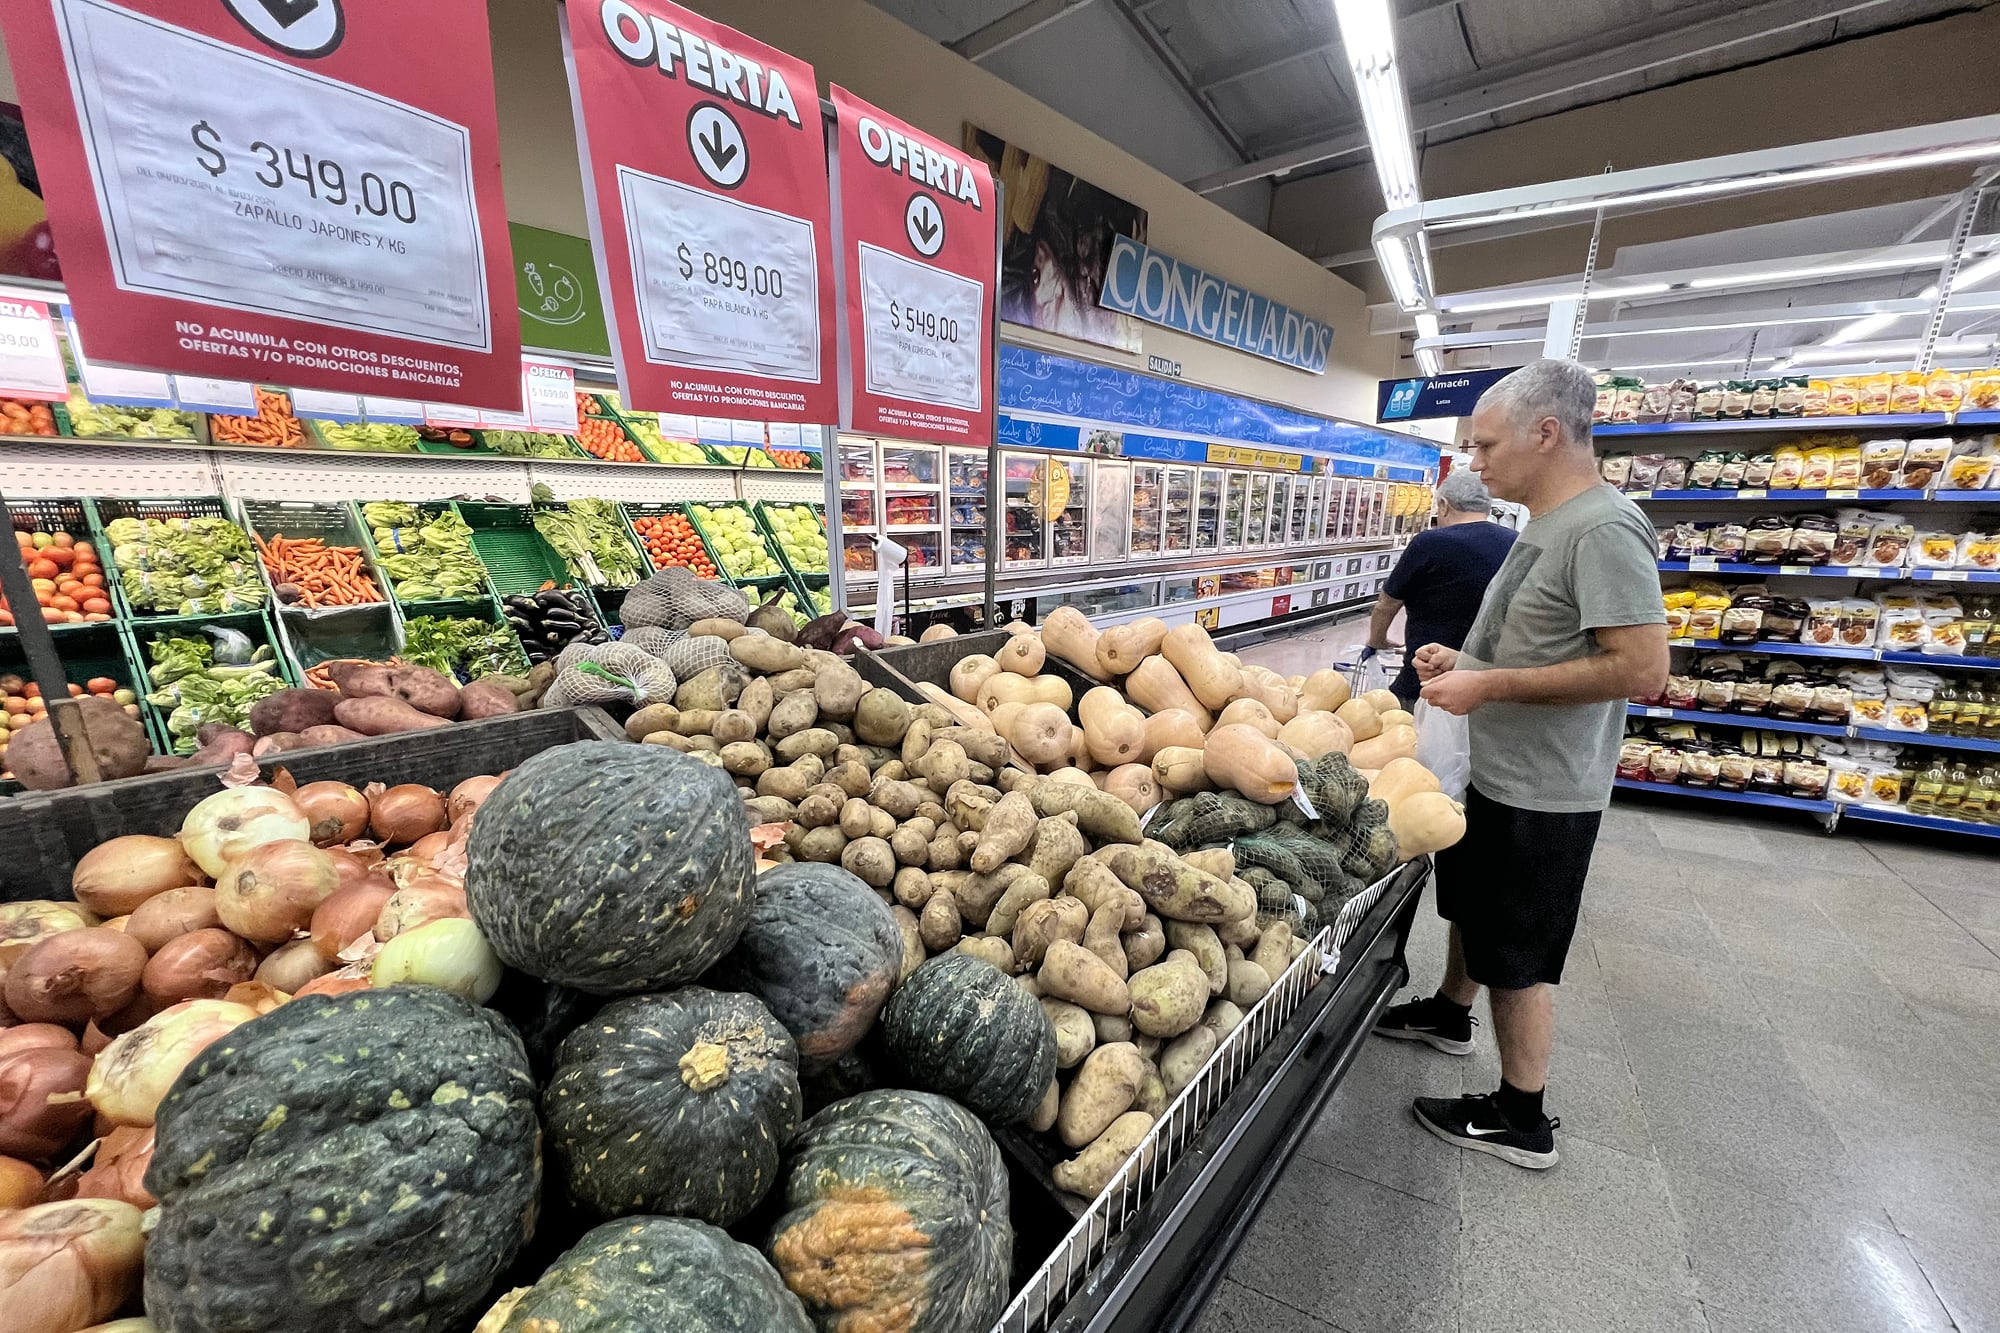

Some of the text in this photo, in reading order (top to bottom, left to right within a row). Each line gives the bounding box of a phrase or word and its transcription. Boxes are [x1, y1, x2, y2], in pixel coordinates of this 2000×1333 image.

[601, 0, 802, 128] OFERTA
[191, 119, 417, 224] $ 349,00
[858, 116, 981, 210] OFERTA
[233, 201, 406, 255] ZAPALLO JAPONES X KG
[677, 242, 693, 281] $
[703, 252, 783, 298] 899,00
[703, 297, 723, 310] PAPA
[725, 300, 751, 317] BLANCA
[759, 309, 769, 320] KG
[890, 300, 958, 343] $ 549,00
[1108, 242, 1329, 370] CONGELADOS
[175, 320, 463, 377] NO ACUMULA CON OTROS DESCUENTOS,
[179, 338, 249, 358] OFERTAS
[287, 353, 389, 377] PROMOCIONES
[391, 369, 461, 387] BANCARIAS
[1000, 349, 1031, 371] gelados
[1149, 357, 1172, 375] SALIDA
[529, 366, 569, 380] OFERTA
[670, 380, 683, 389] NO
[684, 382, 722, 393] ACUMULA
[724, 386, 742, 395] CON
[743, 388, 764, 398] OTROS
[1427, 378, 1470, 390] Almacén
[672, 391, 703, 402] OFERTAS
[721, 396, 769, 408] PROMOCIONES
[770, 401, 805, 411] BANCARIAS
